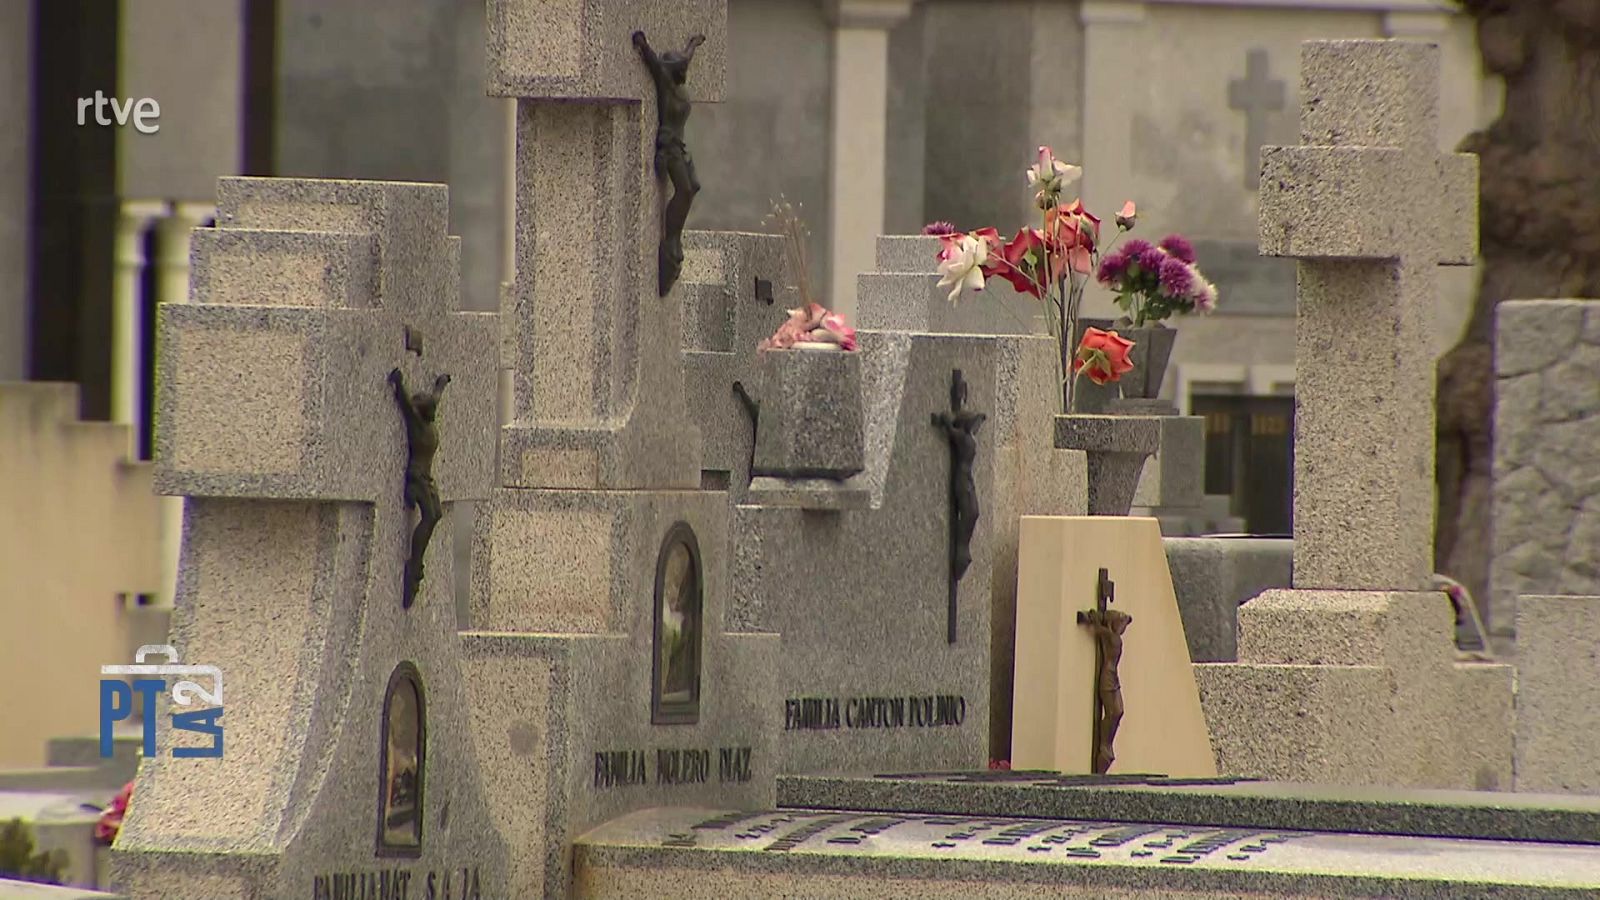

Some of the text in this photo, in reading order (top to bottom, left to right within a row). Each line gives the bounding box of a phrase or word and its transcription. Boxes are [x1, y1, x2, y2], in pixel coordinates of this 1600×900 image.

[785, 698, 840, 730] FAMILIA
[846, 696, 904, 729] CANTON
[594, 750, 646, 788] FAMILIA
